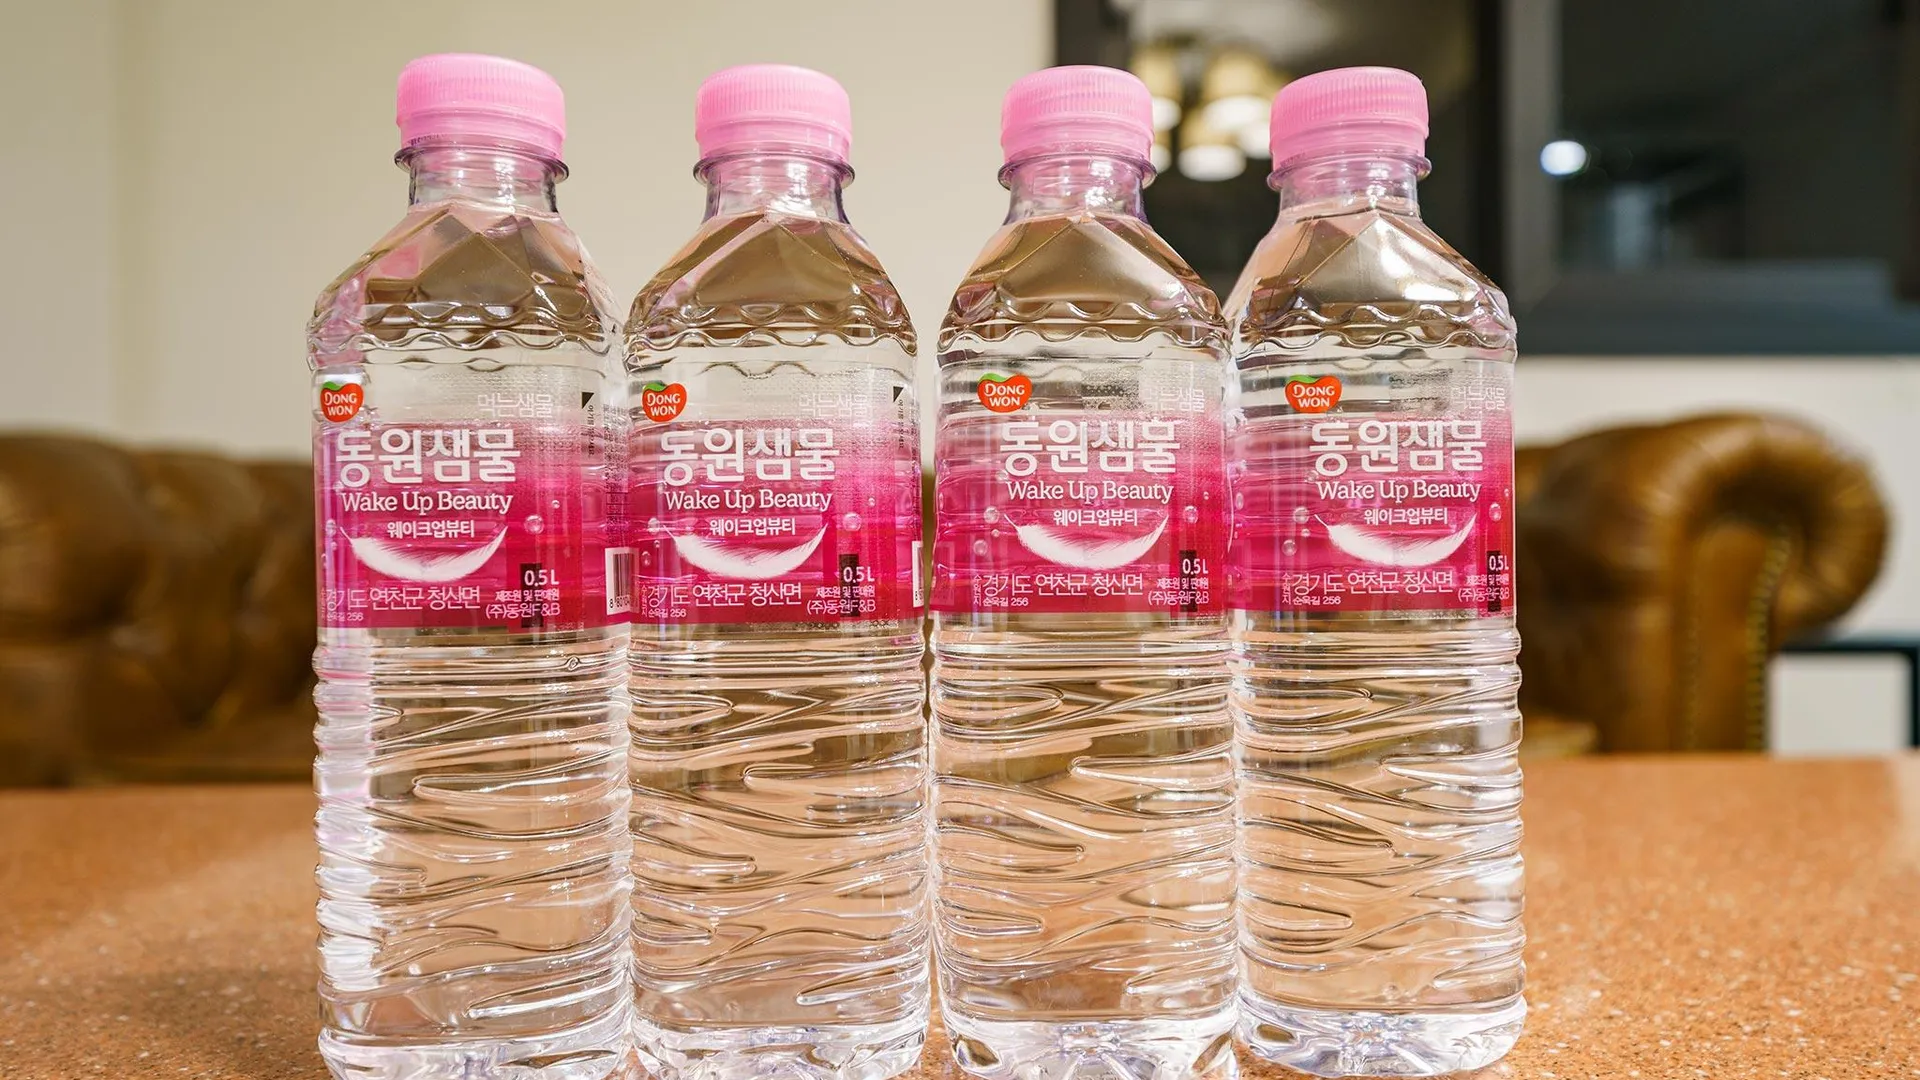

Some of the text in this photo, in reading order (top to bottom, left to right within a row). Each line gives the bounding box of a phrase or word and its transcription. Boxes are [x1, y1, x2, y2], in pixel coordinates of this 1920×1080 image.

[984, 383, 1025, 395] DONG
[1293, 384, 1335, 398] DONG
[324, 392, 357, 405] DONG
[477, 393, 553, 419] 먹는샘물
[647, 392, 681, 406] DONG
[800, 393, 868, 417] 먹는샘물
[989, 396, 1021, 407] WON
[1297, 397, 1331, 408] WON
[327, 405, 354, 416] WON
[650, 406, 677, 417] WON
[659, 427, 840, 487] 동원샘물
[1000, 419, 1181, 477] 동원샘물
[1309, 420, 1487, 477] 동원샘물
[335, 428, 521, 488] 동원샘물
[1006, 480, 1175, 505] Wake Up Beauty
[1316, 479, 1482, 504] Wake Up Beauty
[340, 490, 514, 516] Wake Up Beauty
[664, 489, 833, 514] Wake Up Beauty
[1053, 509, 1138, 527] 웨이크업뷰티
[1364, 507, 1448, 526] 웨이크업뷰티
[387, 520, 475, 539] 웨이크업뷰티
[710, 518, 796, 537] 웨이크업뷰티
[816, 586, 841, 598] 제조원
[982, 572, 1144, 597] 경기도 연천군 청산면
[1291, 570, 1454, 596] 경기도 연천군 청산면
[325, 588, 368, 611] 경기도
[370, 587, 425, 610] 연천군
[427, 585, 481, 610] 청산면
[495, 589, 522, 602] 제조원
[647, 584, 691, 608] 경기도
[693, 583, 747, 607] 연천군
[749, 582, 802, 607] 청산면
[1010, 597, 1029, 607] 256
[1148, 591, 1210, 606] (주)동원F&B
[1322, 595, 1342, 605] 256
[485, 602, 561, 619] (주)동원F&B
[670, 608, 687, 618] 256
[806, 600, 876, 615] (주)동원F&B
